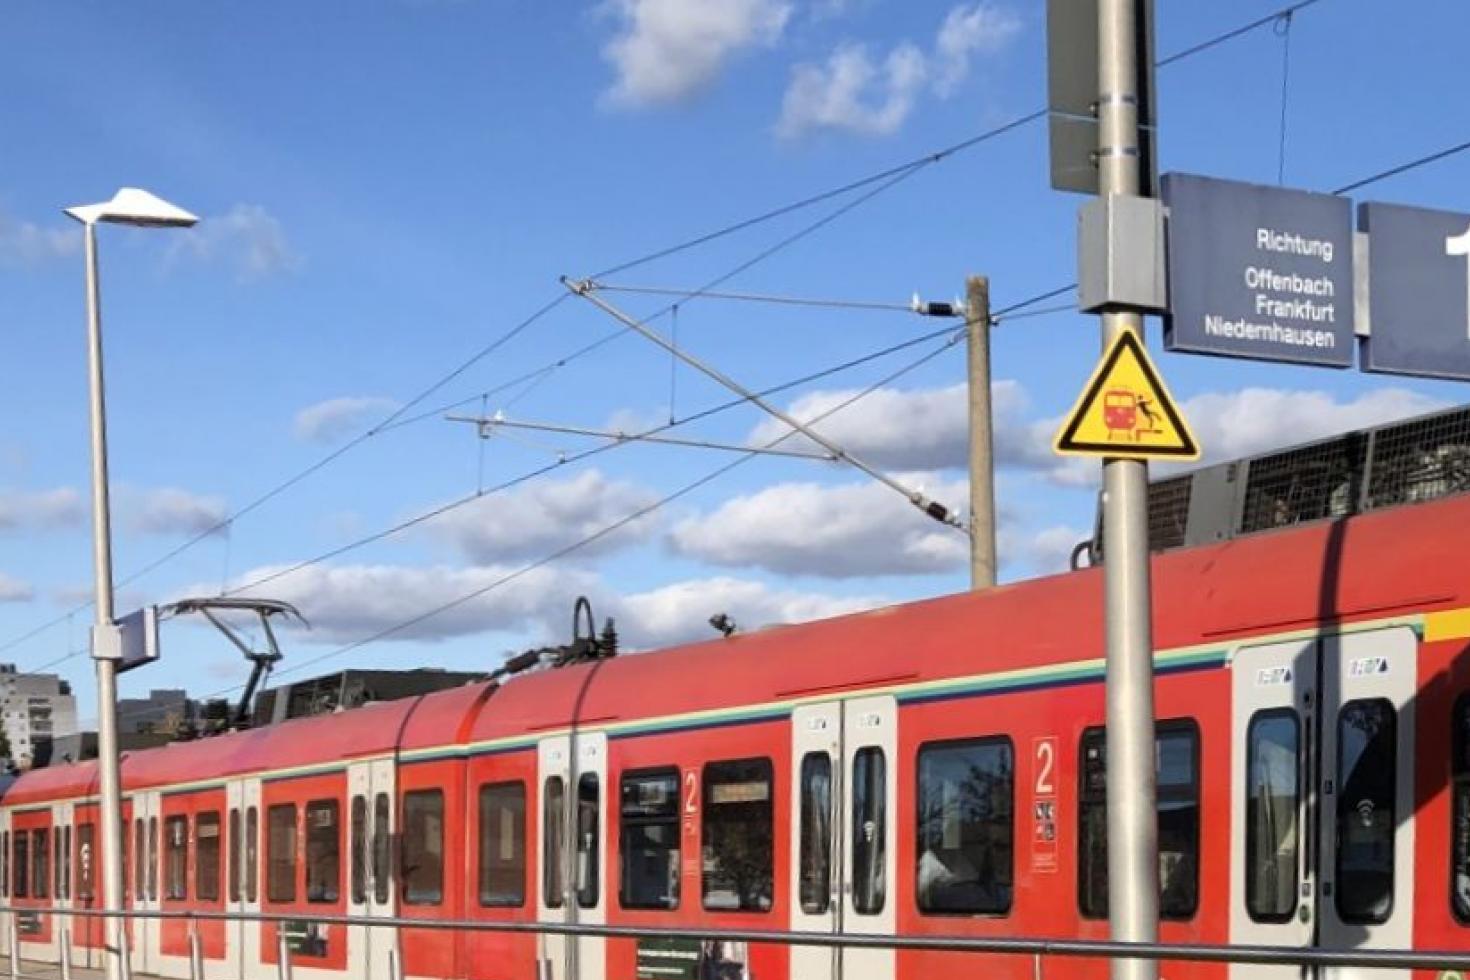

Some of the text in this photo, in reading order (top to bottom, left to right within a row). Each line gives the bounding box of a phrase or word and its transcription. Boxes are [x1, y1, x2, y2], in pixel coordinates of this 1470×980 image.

[1257, 227, 1333, 262] Richtung
[1245, 266, 1334, 297] Offenbach
[1256, 294, 1335, 322] Frankfurt
[1204, 314, 1335, 348] Niedernhausen
[1036, 743, 1053, 793] 2
[686, 772, 698, 813] 2
